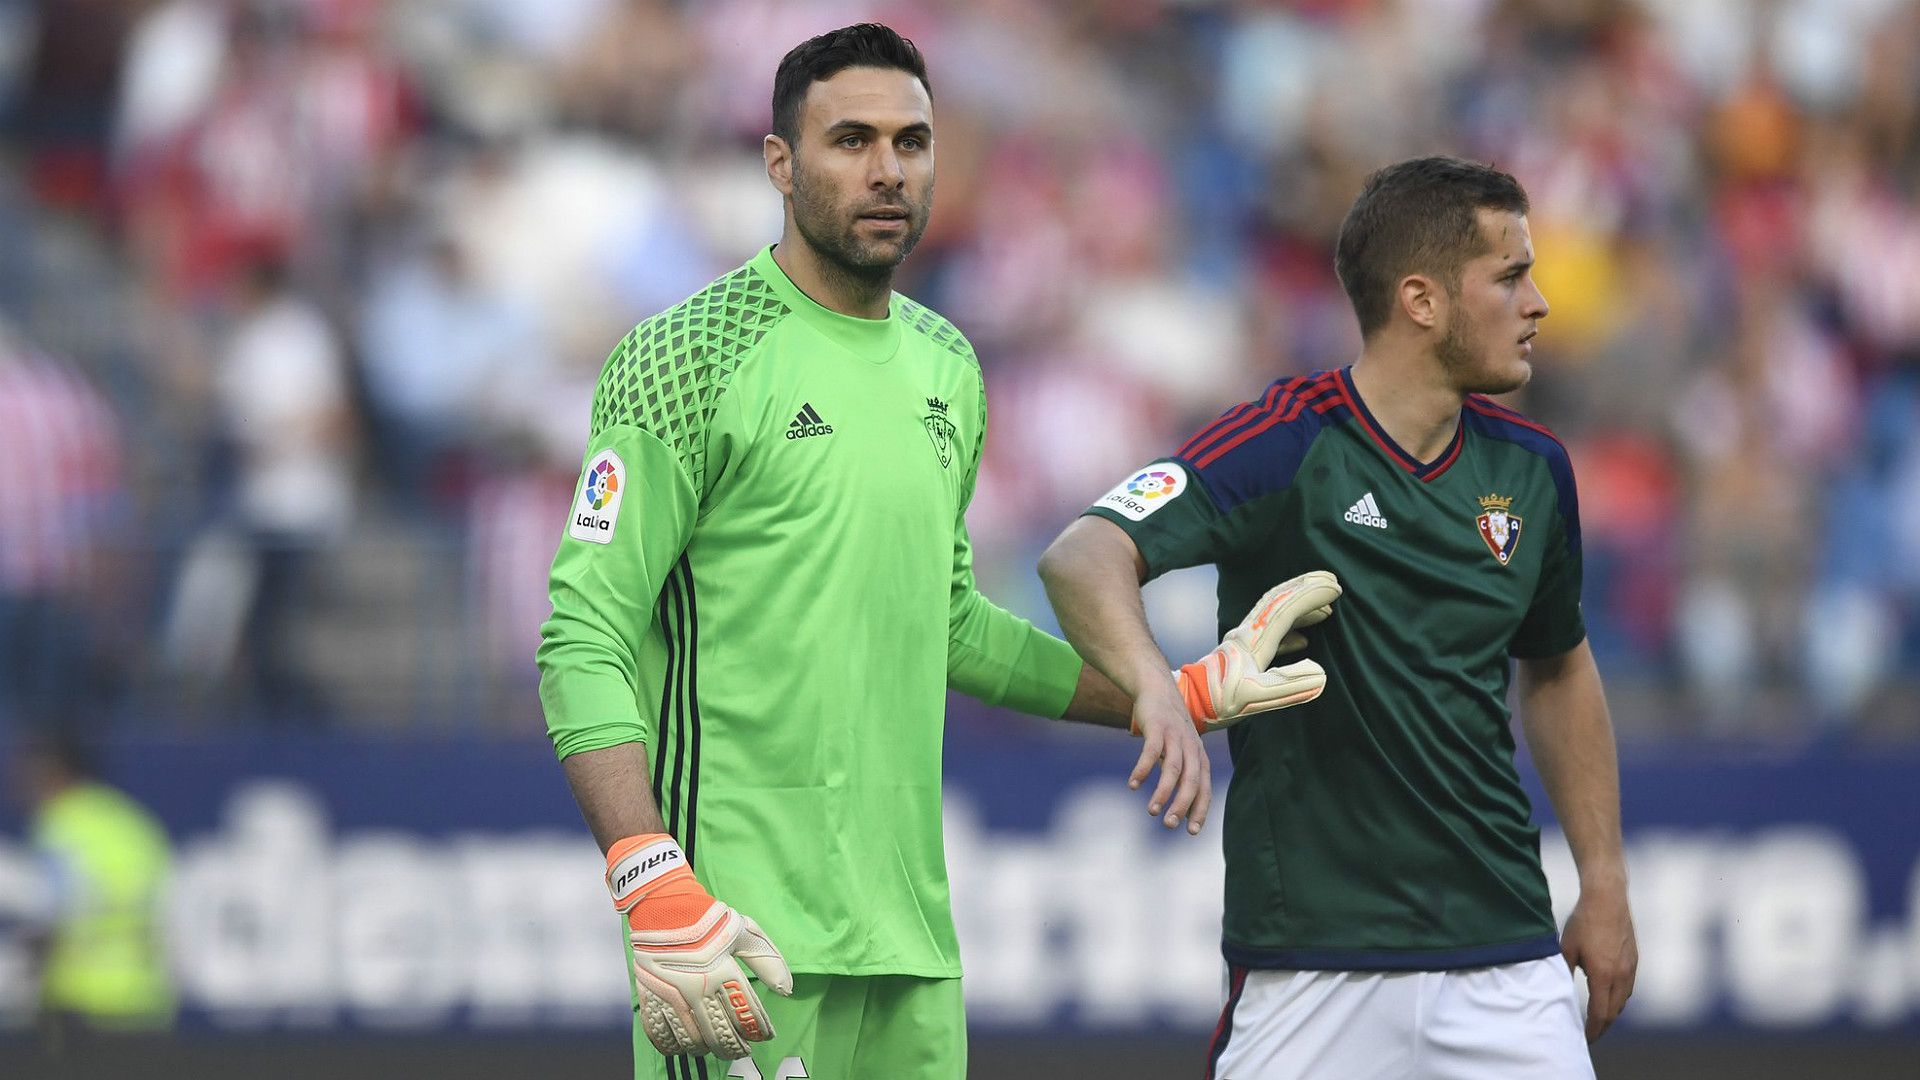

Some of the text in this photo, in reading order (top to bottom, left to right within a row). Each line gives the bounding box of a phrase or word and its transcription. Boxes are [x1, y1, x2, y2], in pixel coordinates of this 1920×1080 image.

[786, 423, 833, 440] adidas
[1344, 511, 1388, 529] adidas
[617, 850, 678, 893] SIRIGU
